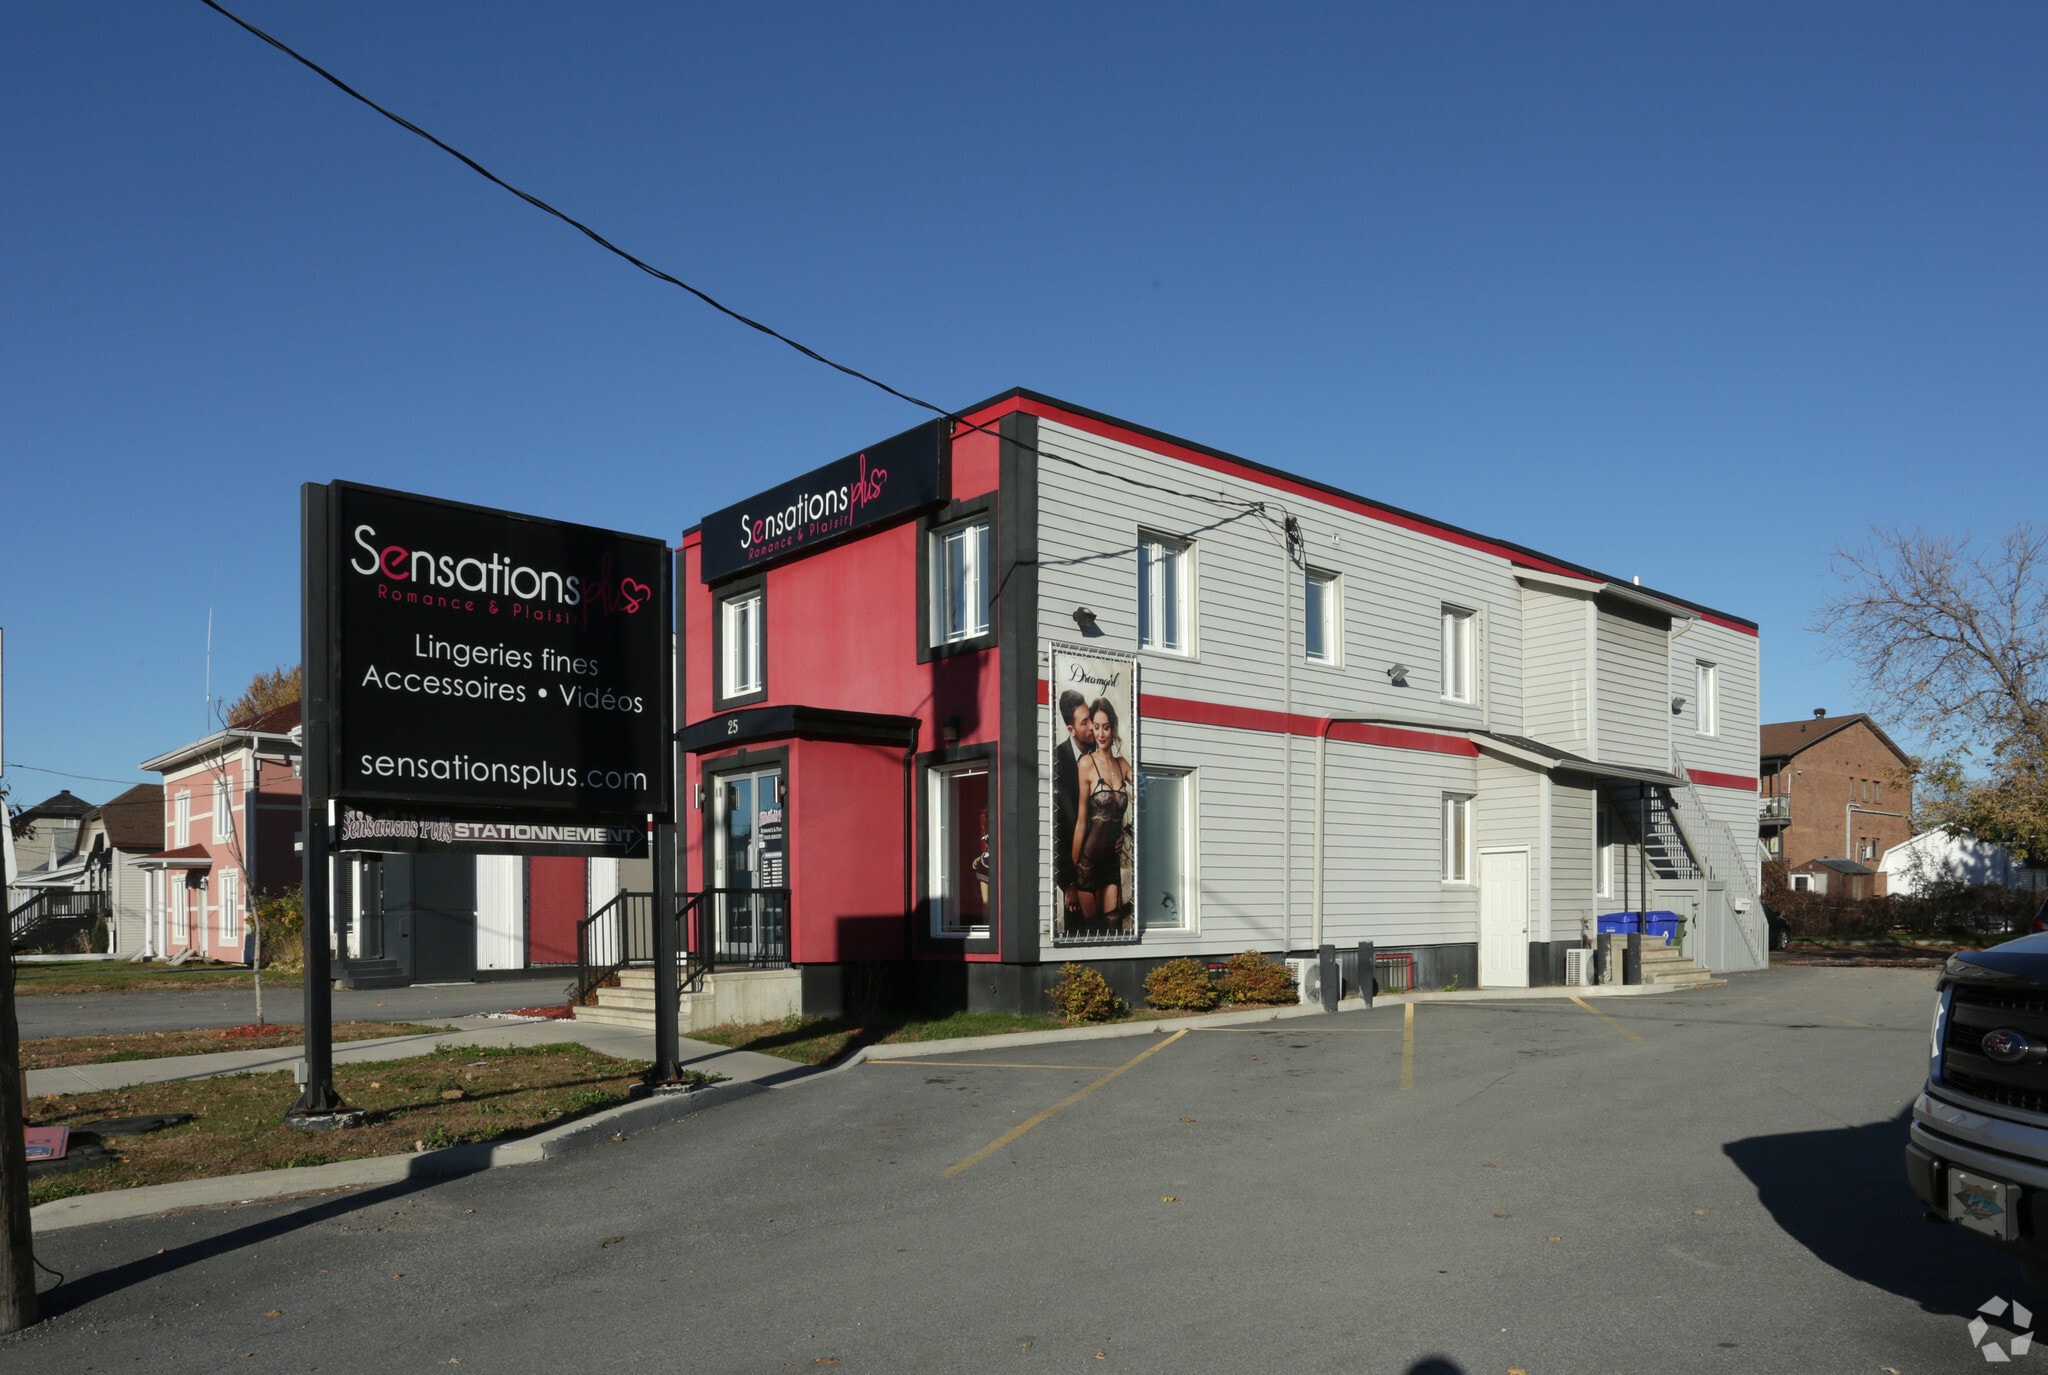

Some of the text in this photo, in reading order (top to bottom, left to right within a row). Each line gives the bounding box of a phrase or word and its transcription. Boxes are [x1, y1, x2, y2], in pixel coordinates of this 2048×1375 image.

[741, 453, 888, 548] Sensations plus
[749, 515, 849, 560] Romance & Plaisir
[351, 524, 581, 606] Sensations
[378, 583, 577, 625] Romance & Plaisir
[415, 633, 599, 677] Lingeries fines
[361, 663, 644, 714] Accessoires Vidéos
[1068, 663, 1120, 696] Dreamgirl
[727, 719, 739, 735] 25
[360, 754, 648, 792] sensationsplus.com
[342, 809, 419, 841] Sensations
[454, 822, 635, 843] STATIONNEMENT
